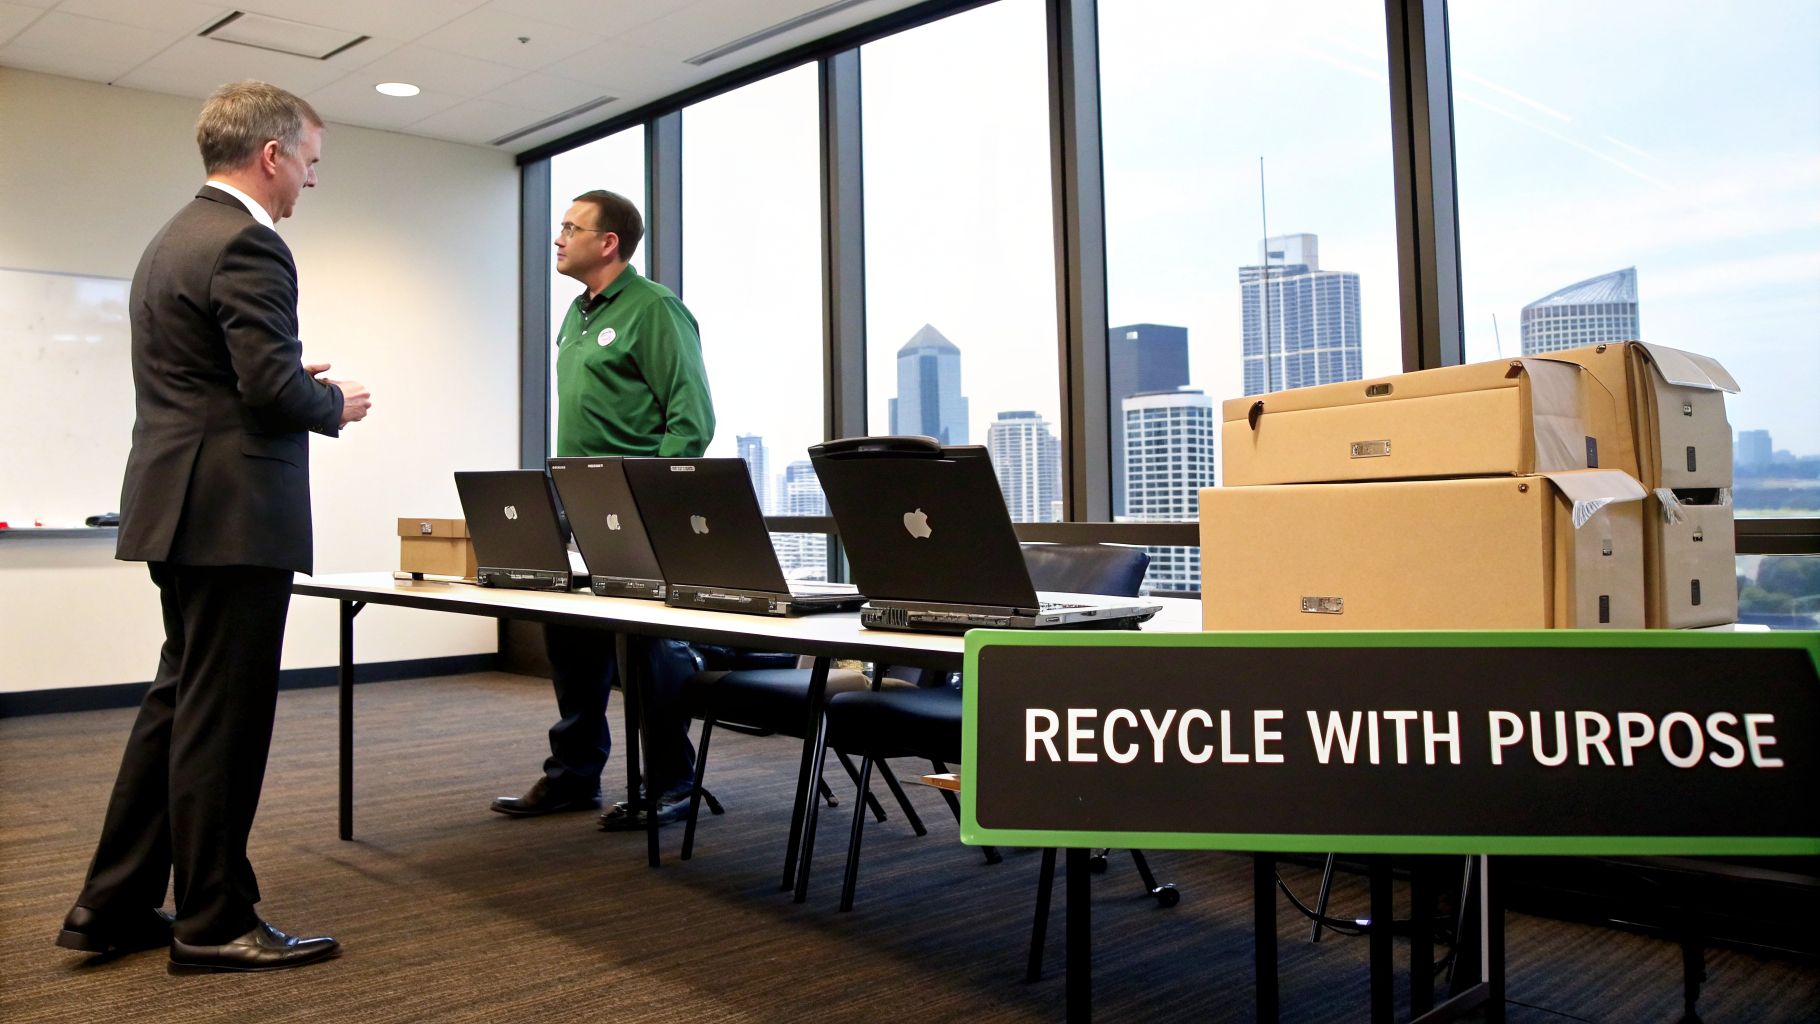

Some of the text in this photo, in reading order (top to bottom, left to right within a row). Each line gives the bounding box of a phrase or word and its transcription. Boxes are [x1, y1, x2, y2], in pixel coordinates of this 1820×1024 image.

[1025, 708, 1784, 768] RECYCLE WITH PURPOSE
